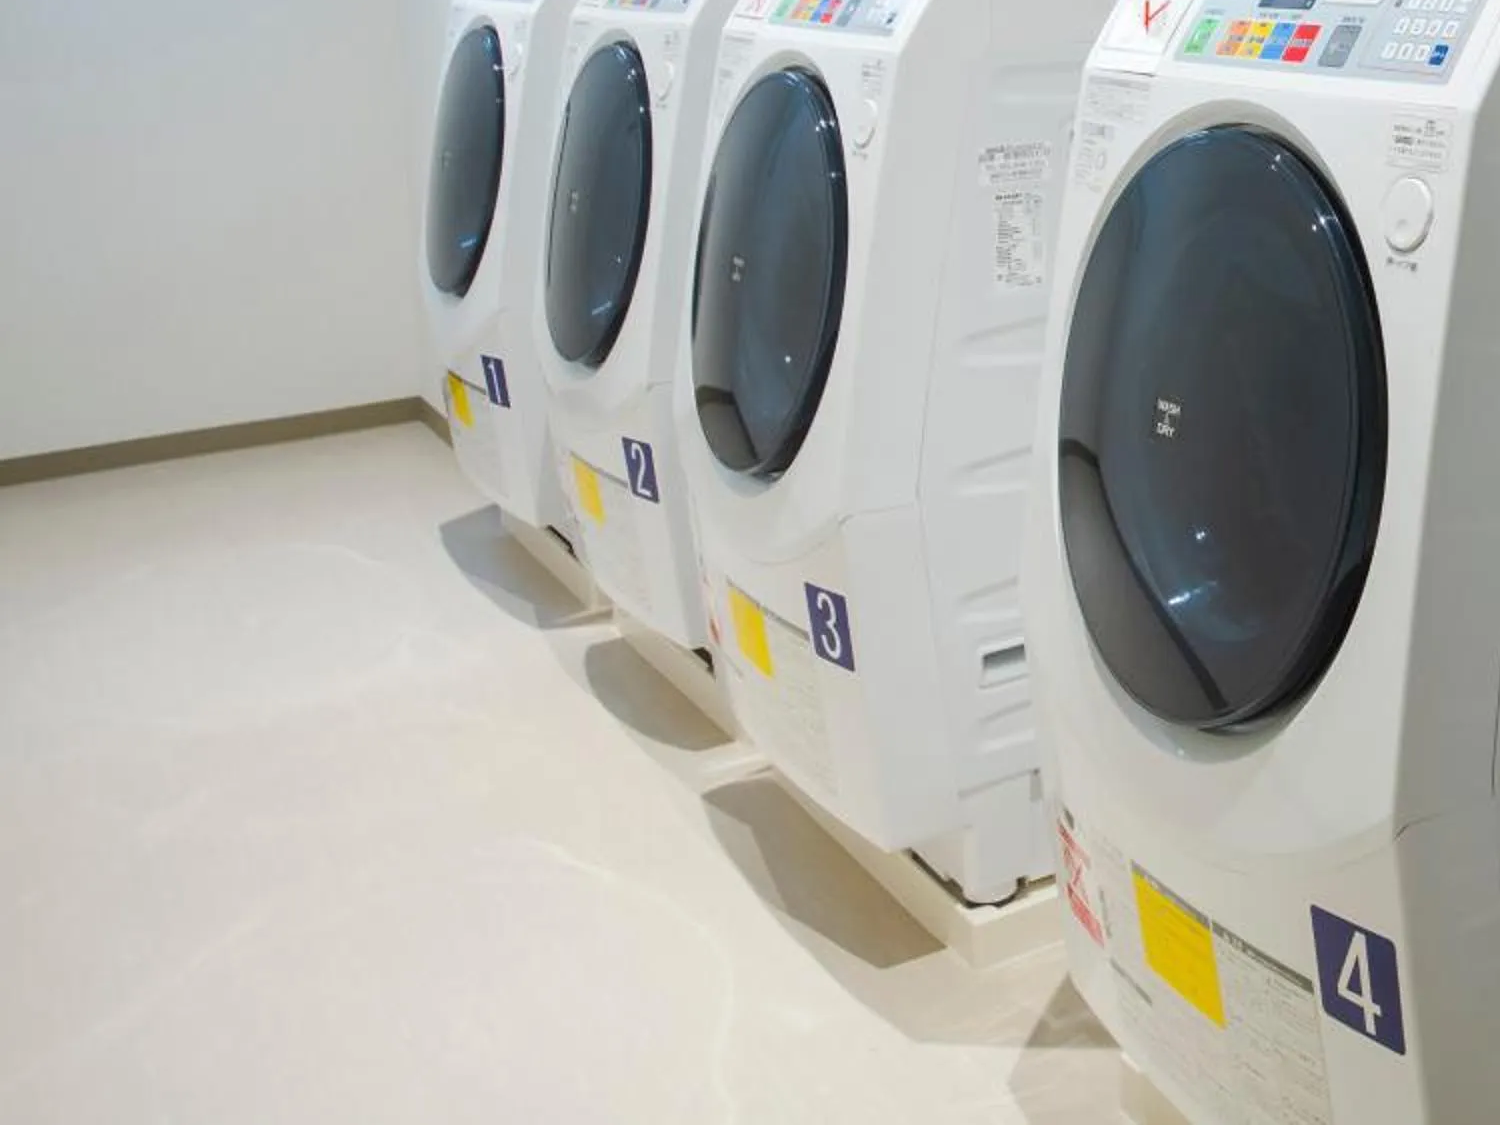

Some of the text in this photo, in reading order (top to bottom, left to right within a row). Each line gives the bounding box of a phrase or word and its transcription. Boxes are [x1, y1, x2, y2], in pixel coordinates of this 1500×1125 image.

[487, 361, 502, 405] 1
[630, 442, 652, 498] 2
[816, 591, 842, 660] 3
[1337, 931, 1382, 1036] 4
